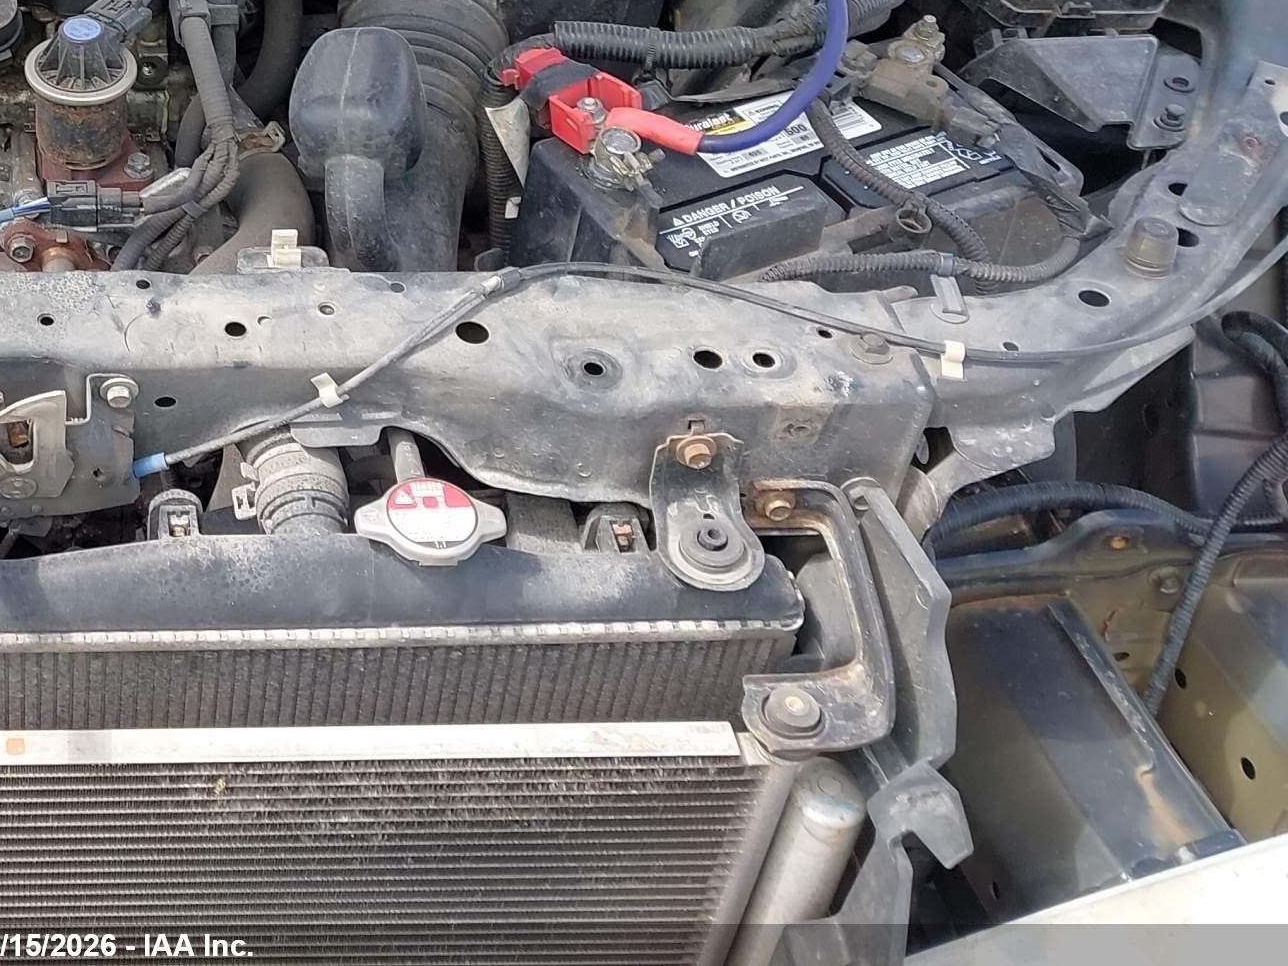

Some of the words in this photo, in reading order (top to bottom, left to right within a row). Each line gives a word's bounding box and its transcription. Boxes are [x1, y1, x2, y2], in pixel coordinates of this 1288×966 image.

[685, 113, 733, 131] uralast
[682, 202, 730, 223] DANGER
[737, 185, 781, 205] POISON
